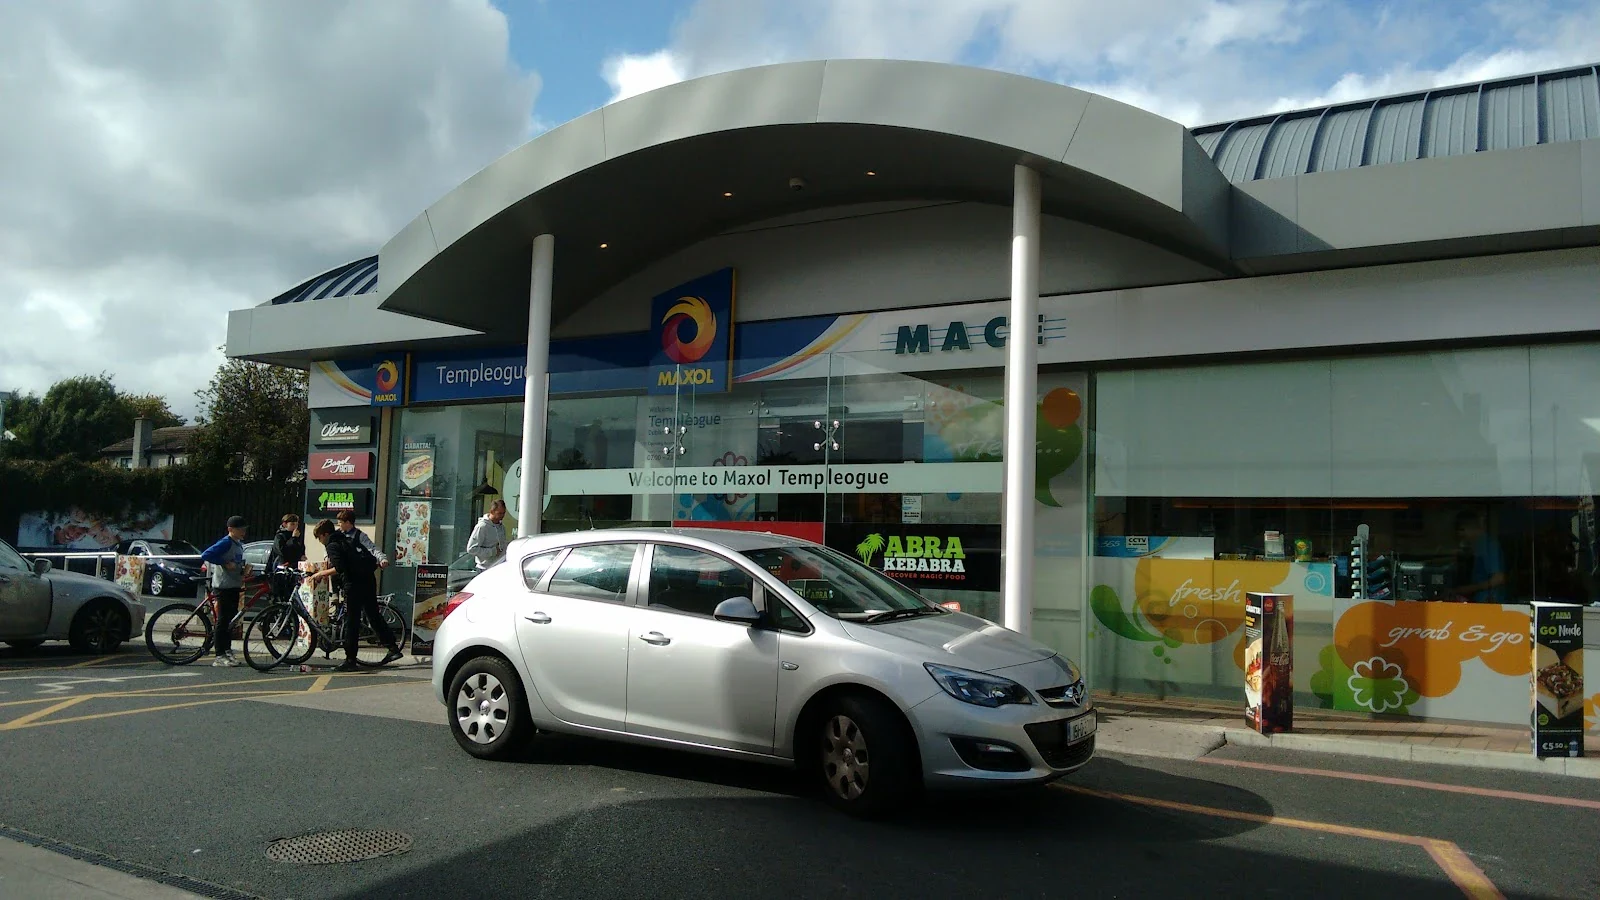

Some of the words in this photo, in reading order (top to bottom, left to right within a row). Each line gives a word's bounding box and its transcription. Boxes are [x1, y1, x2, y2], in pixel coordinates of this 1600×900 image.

[657, 368, 714, 386] MAXOL
[375, 394, 397, 402] MAXOL
[628, 470, 697, 487] Welcome
[702, 472, 718, 486] to
[723, 469, 770, 486] Maxol
[779, 468, 889, 489] Templeogue
[327, 492, 354, 502] ABRA
[884, 535, 966, 559] ABRA
[884, 557, 966, 573] KEBABRA
[1169, 578, 1241, 607] fresh
[1380, 621, 1453, 647] grab
[1458, 625, 1490, 642] &
[1481, 632, 1524, 653] go
[1540, 625, 1557, 636] GO
[1558, 623, 1582, 637] Nude
